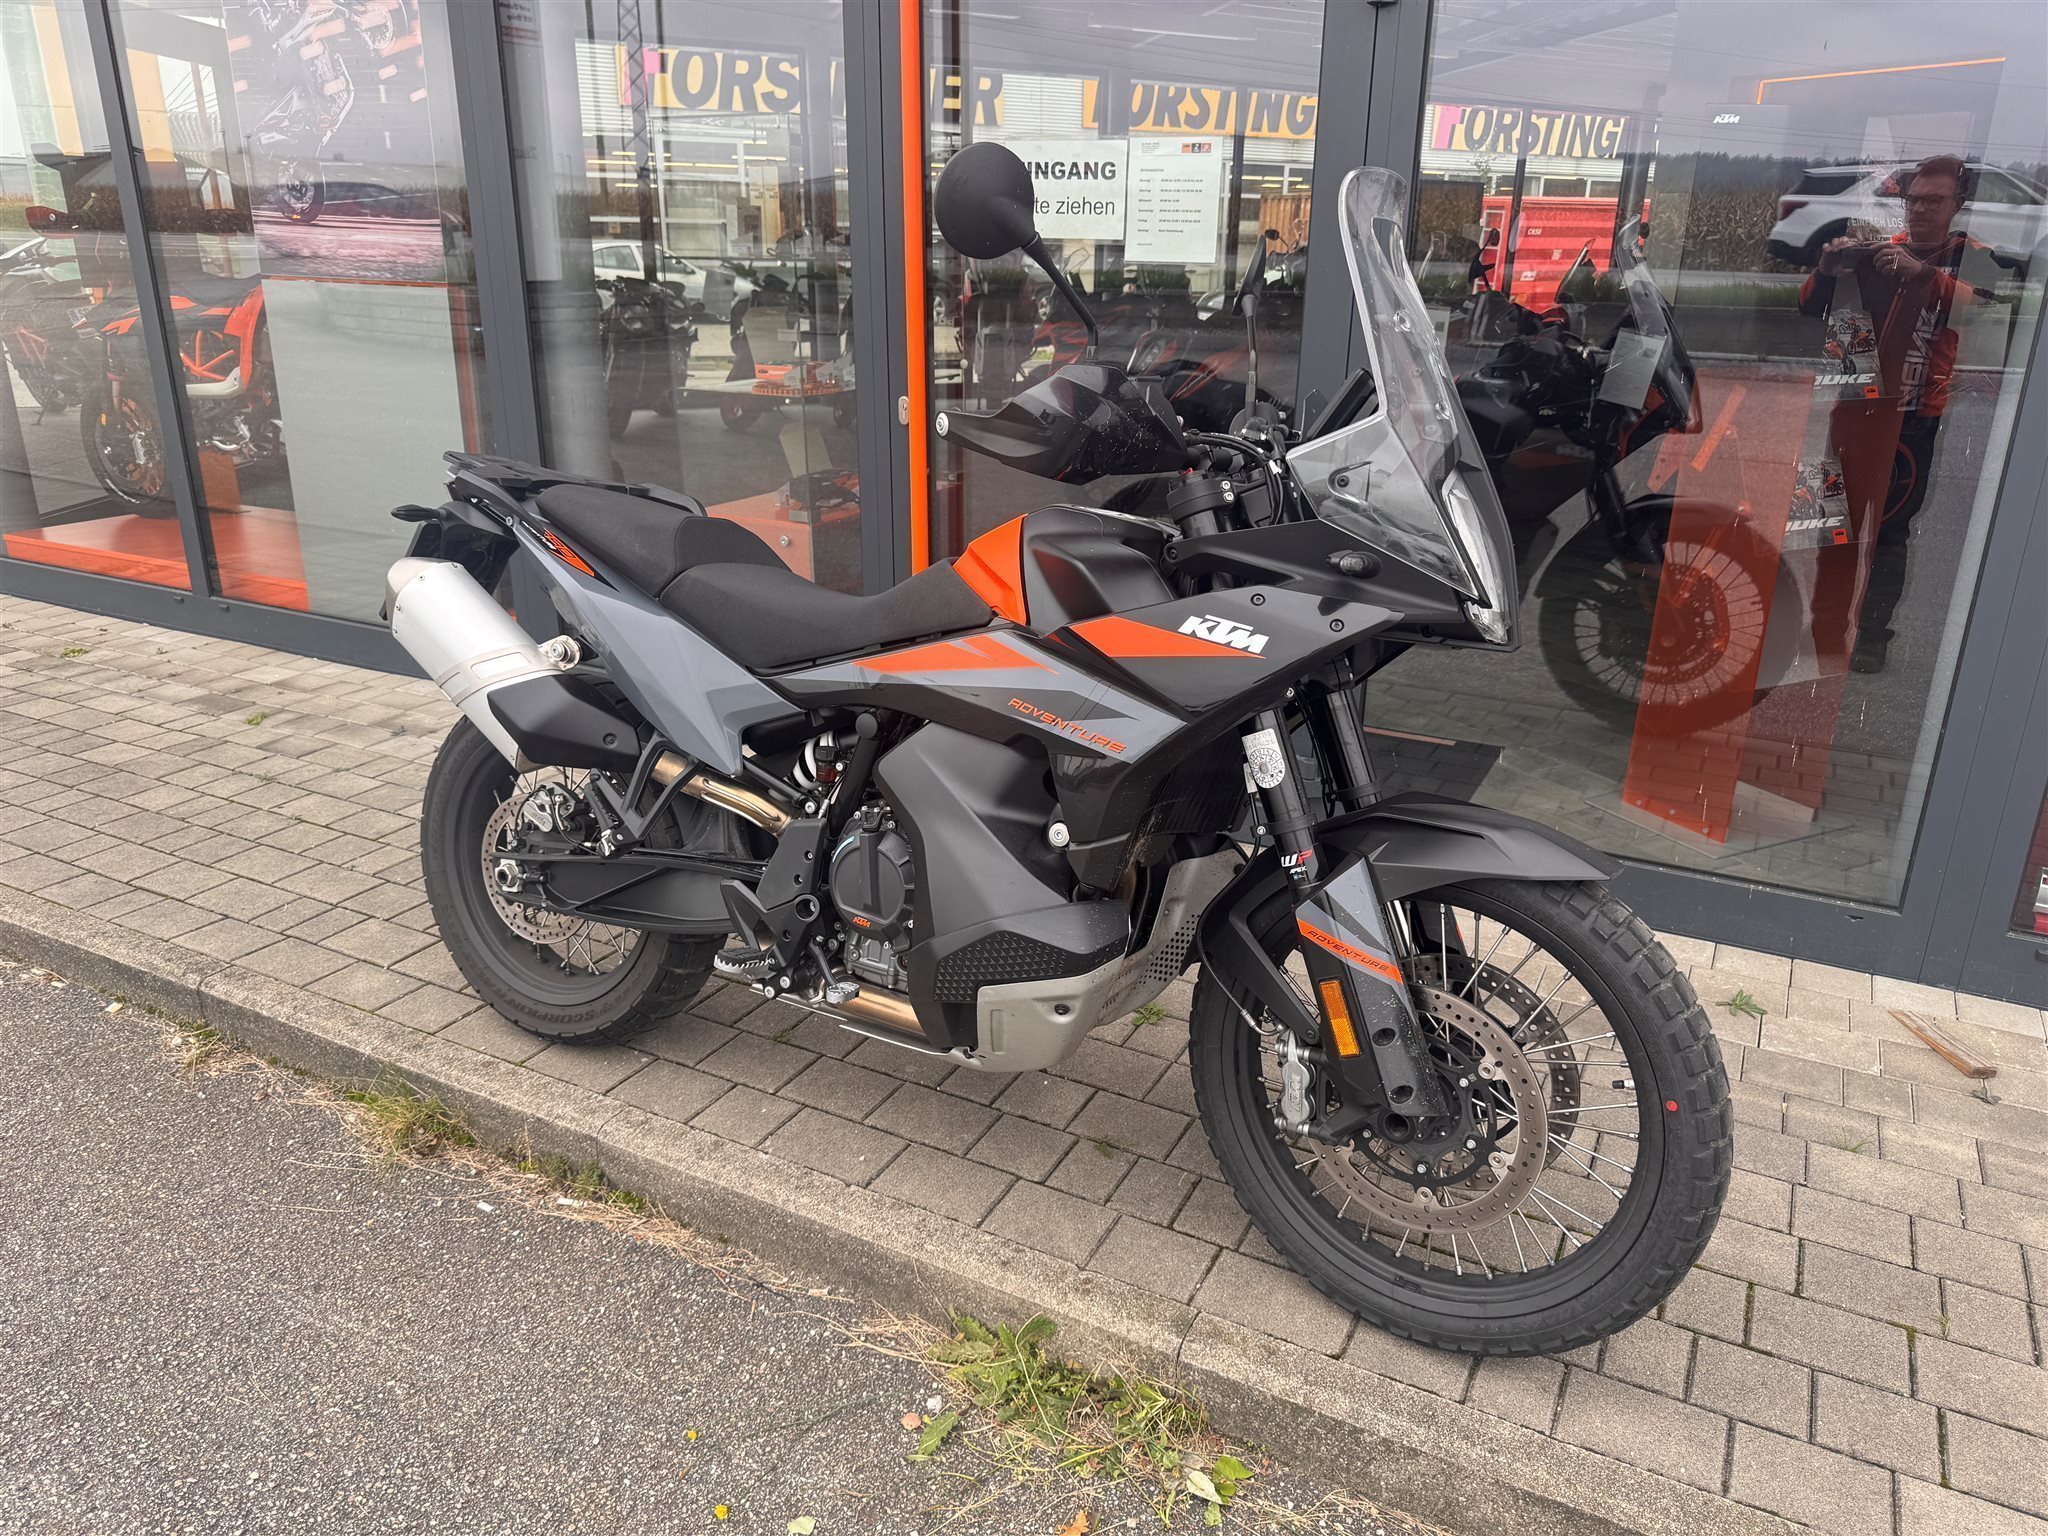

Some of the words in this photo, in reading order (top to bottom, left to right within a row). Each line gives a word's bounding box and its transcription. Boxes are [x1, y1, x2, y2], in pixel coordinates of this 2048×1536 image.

[1093, 82, 1317, 136] ORSTING
[1713, 113, 1741, 124] KTM
[1434, 105, 1626, 159] FORSTING
[1026, 161, 1117, 181] INGANG
[1055, 195, 1116, 215] ziehen
[1886, 217, 1904, 228] LOS
[1177, 613, 1270, 655] KTM
[1007, 697, 1127, 754] ADVENTURE
[1306, 929, 1390, 972] ADVENTURE
